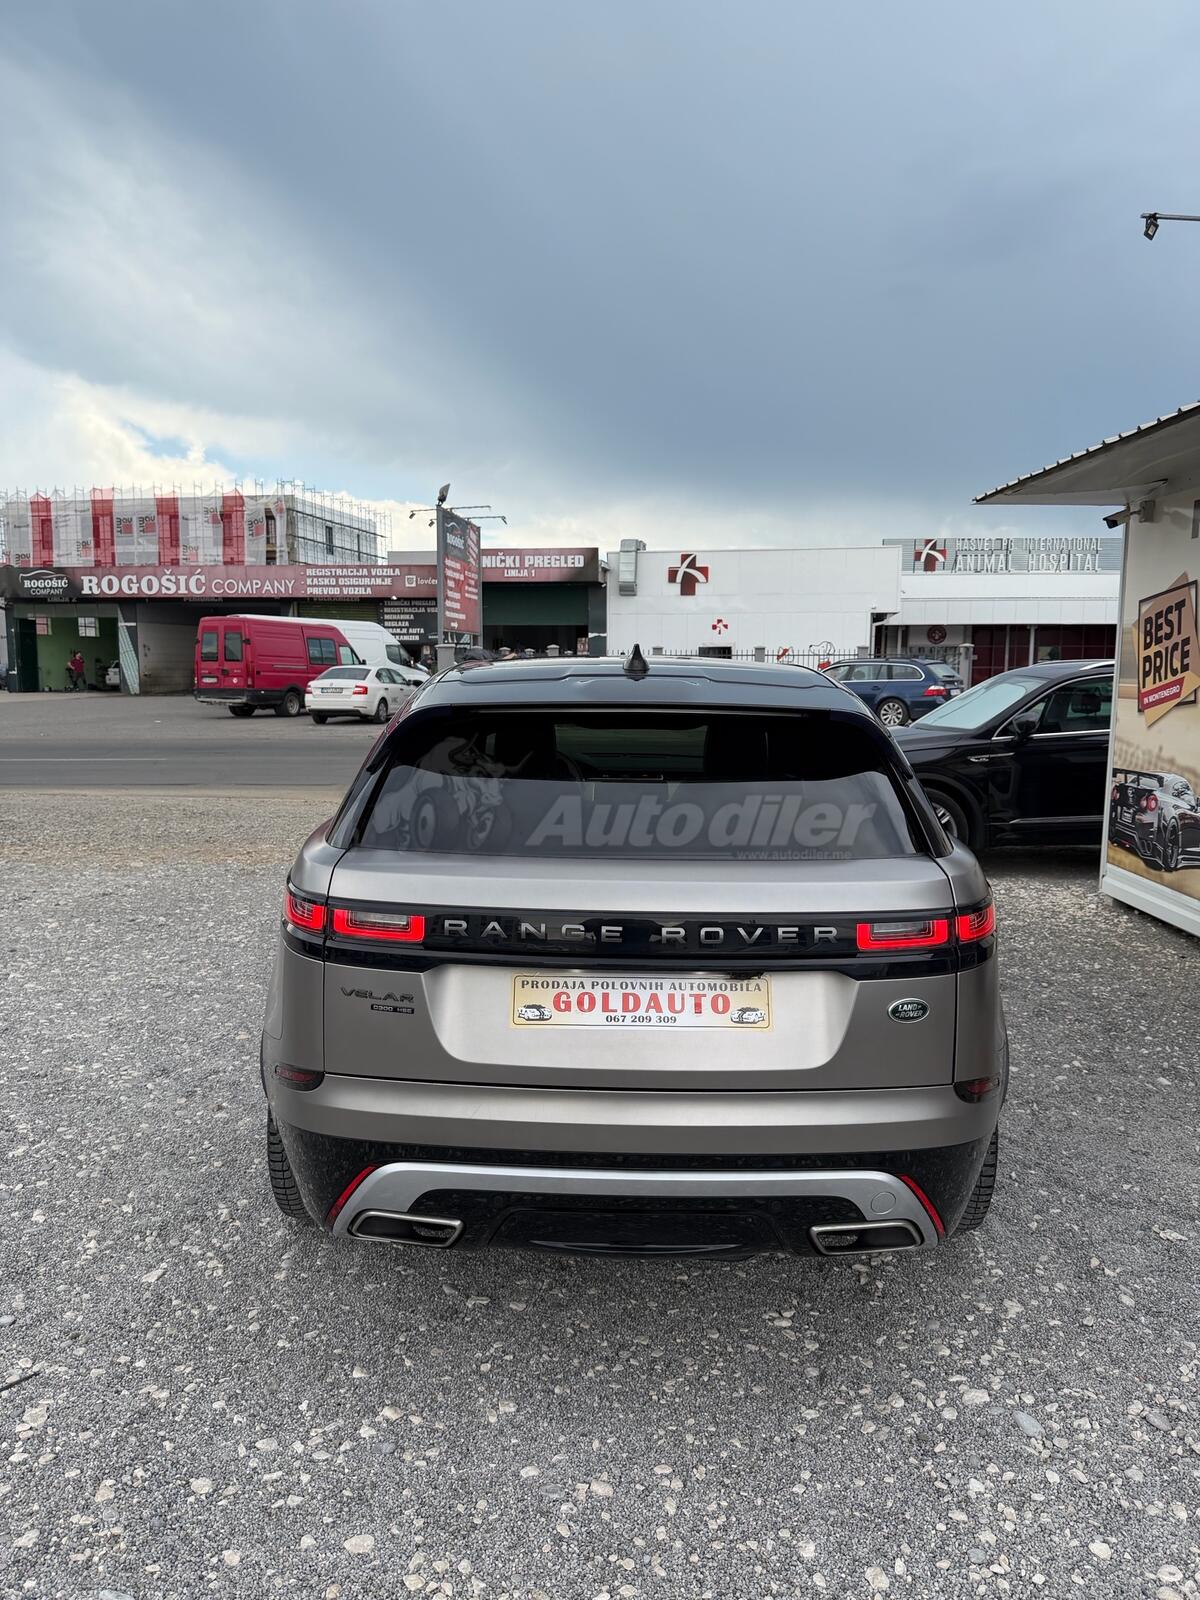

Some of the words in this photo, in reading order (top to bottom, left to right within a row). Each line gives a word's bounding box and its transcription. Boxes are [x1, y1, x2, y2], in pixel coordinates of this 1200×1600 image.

[481, 552, 520, 568] NIČKI
[524, 555, 585, 568] PREGLED
[956, 554, 1013, 571] ANIMAL
[1028, 554, 1102, 571] HOSPITAL
[306, 568, 369, 576] REGISTRACIJA
[371, 568, 400, 576] VOZILA
[504, 569, 528, 577] LINIJA
[531, 569, 535, 577] 1
[24, 578, 69, 588] ROGOŠIĆ
[81, 568, 206, 595] ROGOŠIĆ
[211, 579, 296, 594] COMPANY
[306, 577, 336, 586] KASKO
[338, 577, 393, 586] OSIGURANJE
[30, 588, 63, 596] COMPANY
[306, 587, 340, 595] PREVOD
[343, 587, 372, 595] VOZILA
[1143, 599, 1186, 651] BEST
[1142, 636, 1191, 689] PRICE
[443, 919, 624, 943] RANGE
[661, 926, 839, 944] ROVER
[521, 980, 586, 990] PRODAJA
[591, 980, 664, 991] POLOVNIH
[669, 981, 762, 992] AUTOMOBILA
[340, 986, 415, 1003] VELAR
[553, 991, 731, 1014] GOLDAUTO
[605, 1014, 627, 1023] 067
[630, 1014, 652, 1023] 209
[655, 1015, 677, 1024] 309
